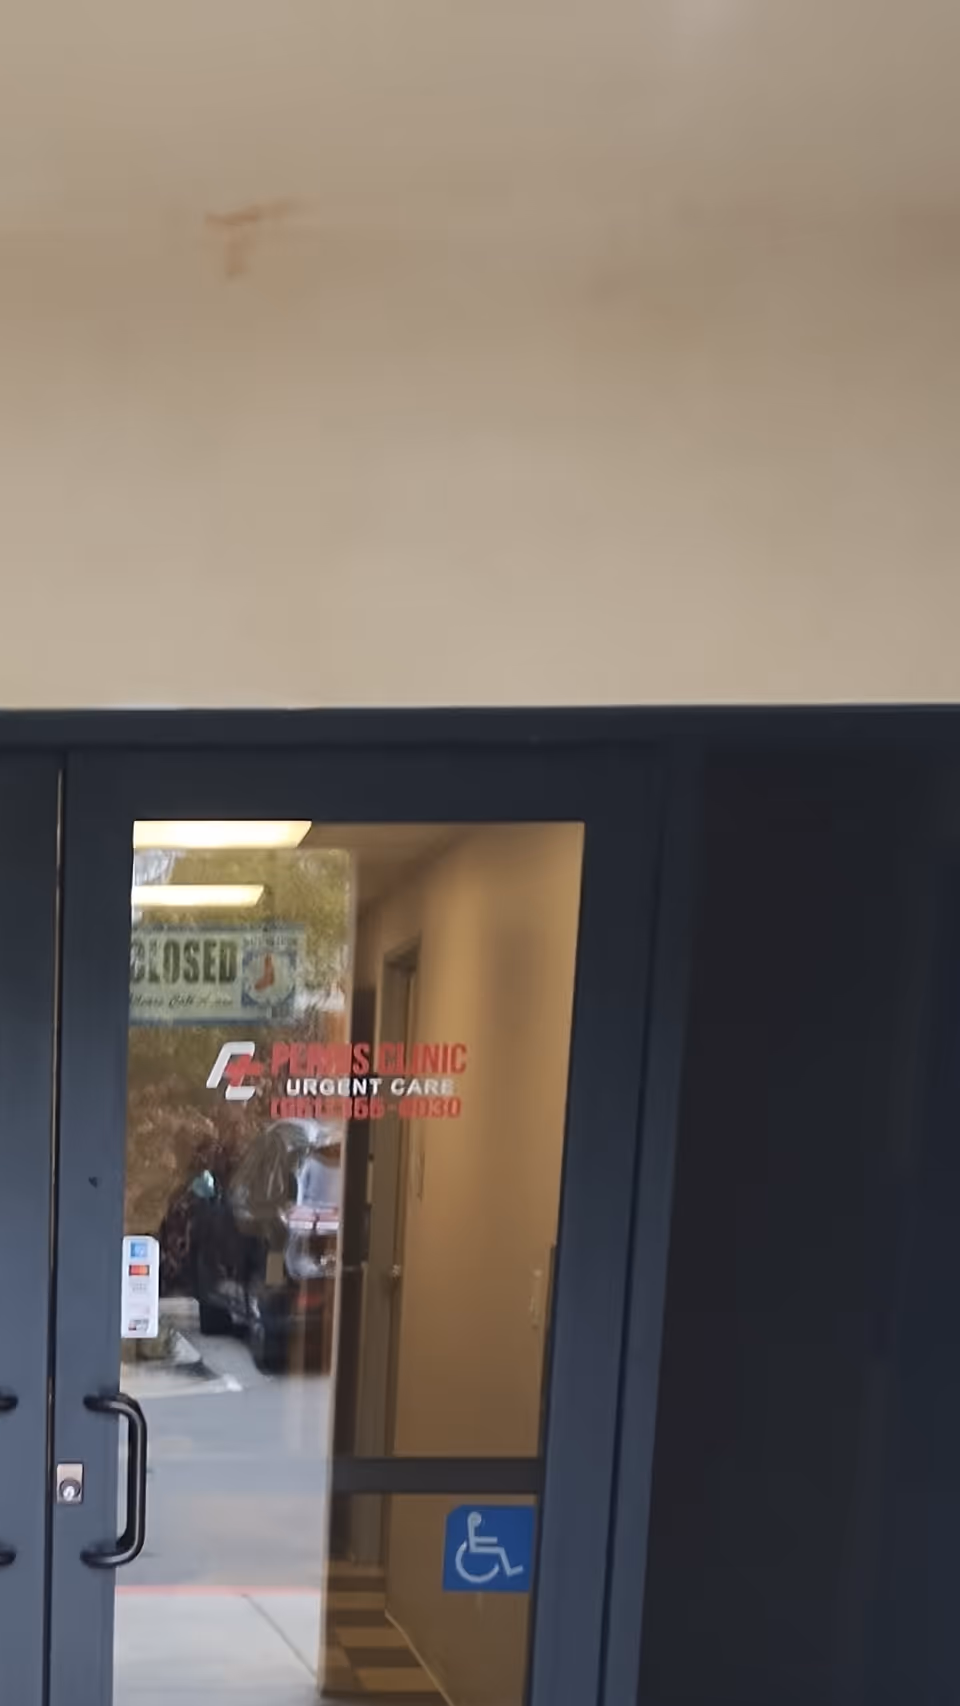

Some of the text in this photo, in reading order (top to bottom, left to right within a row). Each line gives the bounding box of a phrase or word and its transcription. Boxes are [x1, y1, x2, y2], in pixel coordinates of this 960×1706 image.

[129, 939, 239, 984] CLOSED
[377, 1042, 468, 1075] CLINIC
[286, 1077, 455, 1096] URGENT CARE
